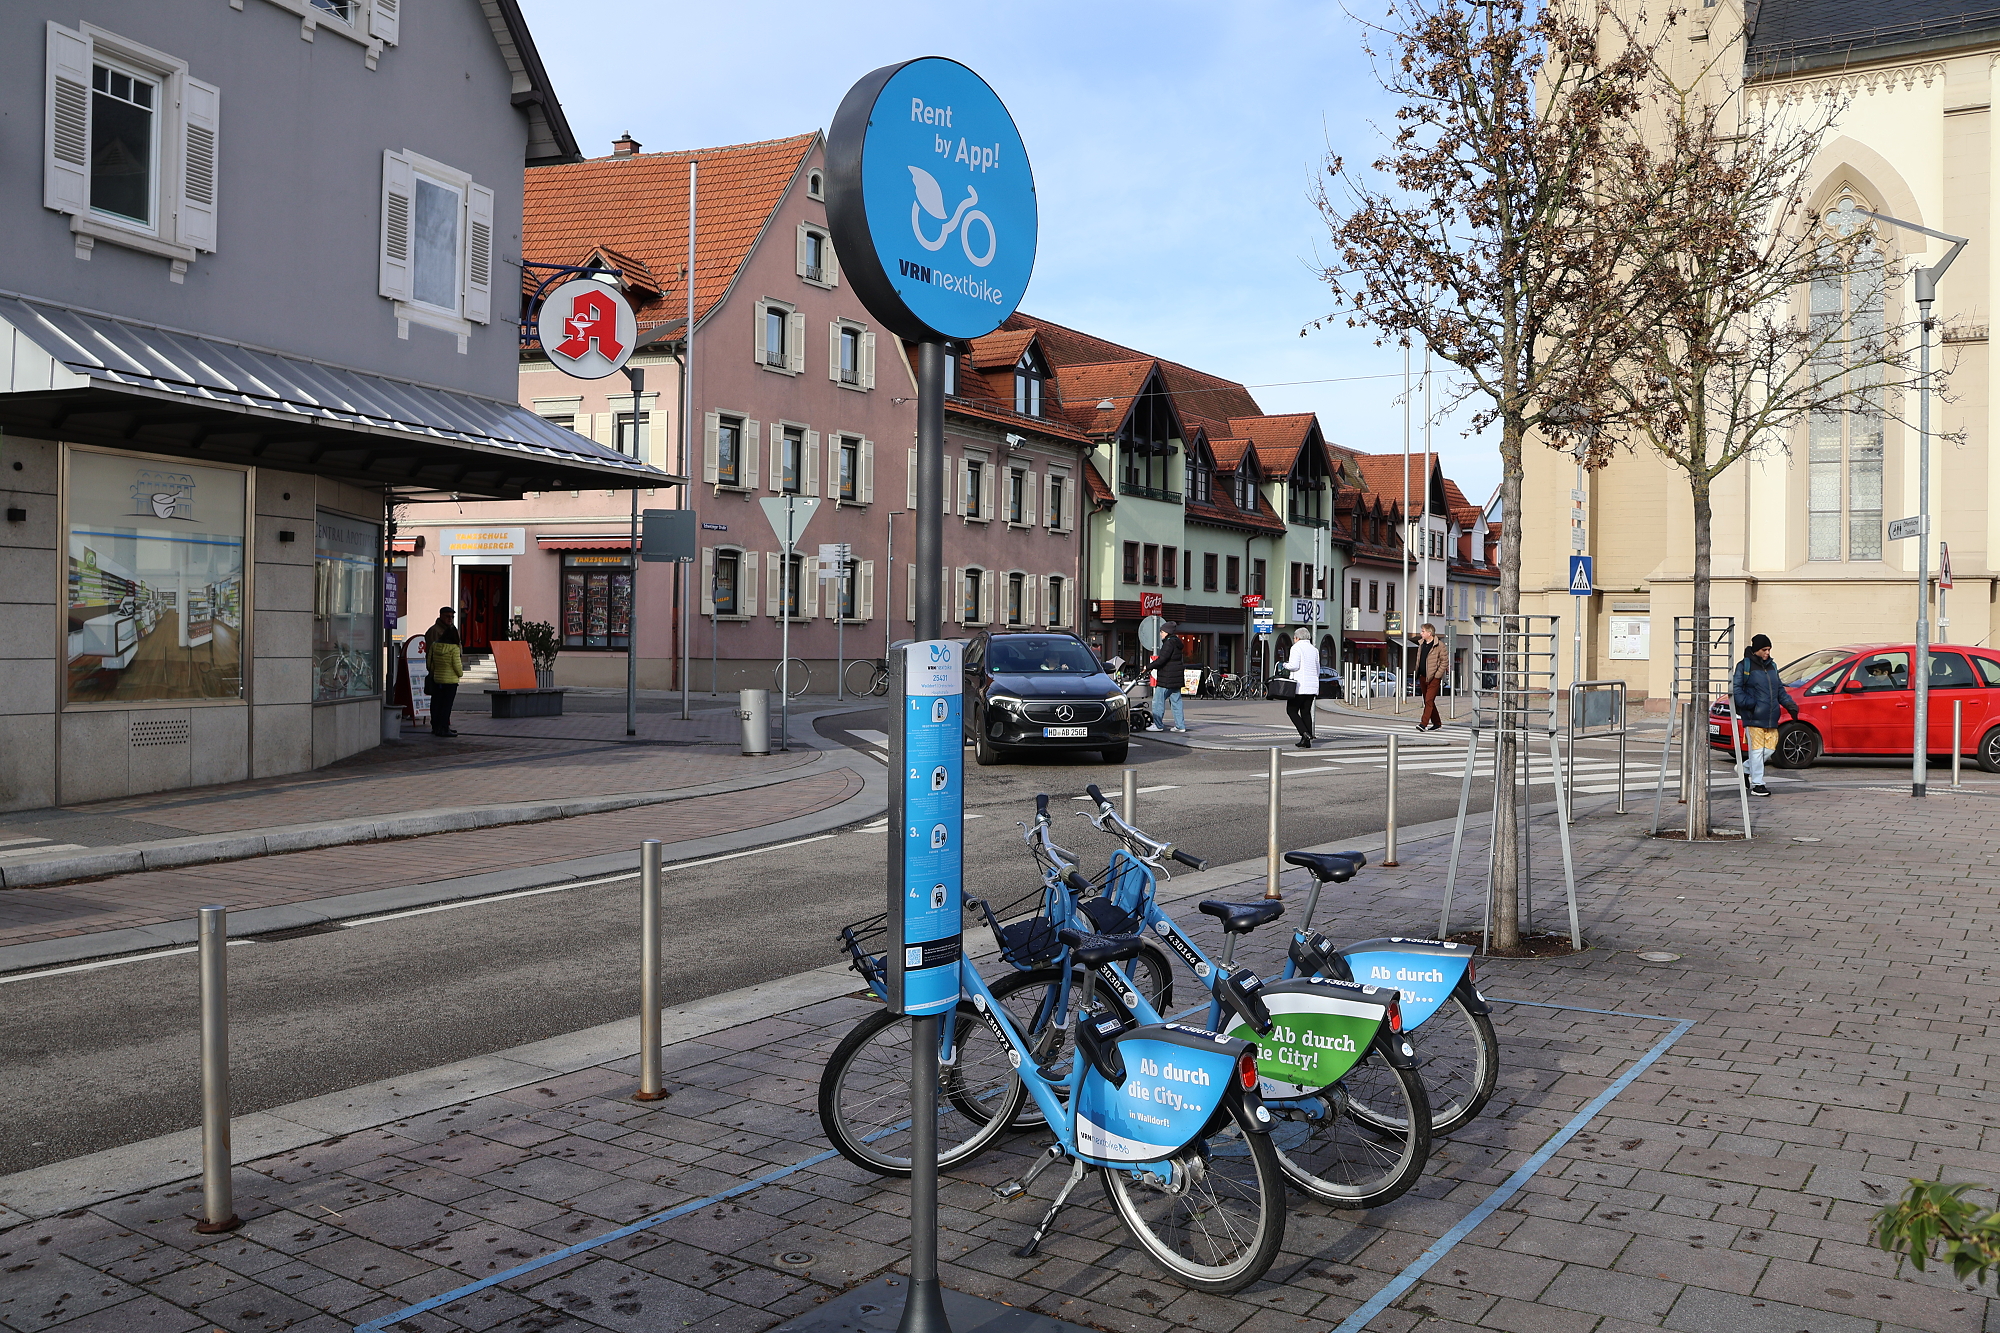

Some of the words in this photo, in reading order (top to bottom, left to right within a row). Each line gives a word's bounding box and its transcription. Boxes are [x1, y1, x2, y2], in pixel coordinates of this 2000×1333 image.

[911, 97, 952, 128] Rent
[935, 133, 951, 159] by
[955, 137, 1000, 173] App!
[899, 258, 931, 284] VRN
[933, 268, 1003, 305] nextbike
[455, 532, 509, 540] TANZSCHULE
[448, 542, 515, 551] KRONENBERGER
[1144, 596, 1162, 609] Görtz
[1242, 596, 1260, 604] Görtz
[910, 699, 920, 711] 1.
[1048, 728, 1057, 736] HD
[910, 768, 920, 779] 2.
[909, 826, 920, 838] 3.
[909, 887, 920, 898] 4.
[1167, 934, 1196, 965] 430166
[1100, 964, 1125, 994] 30306
[1370, 966, 1391, 980] Ab
[1396, 967, 1443, 983] durch
[984, 1011, 1011, 1050] 430873
[1271, 1025, 1297, 1045] Ab
[1301, 1030, 1356, 1053] durch
[1256, 1042, 1273, 1061] ie
[1278, 1046, 1318, 1072] City!
[1140, 1057, 1159, 1077] Ab
[1163, 1062, 1210, 1087] durch
[1127, 1081, 1150, 1101] die
[1153, 1087, 1202, 1112] City...
[1128, 1109, 1138, 1120] in
[1137, 1112, 1170, 1128] Walldorf!
